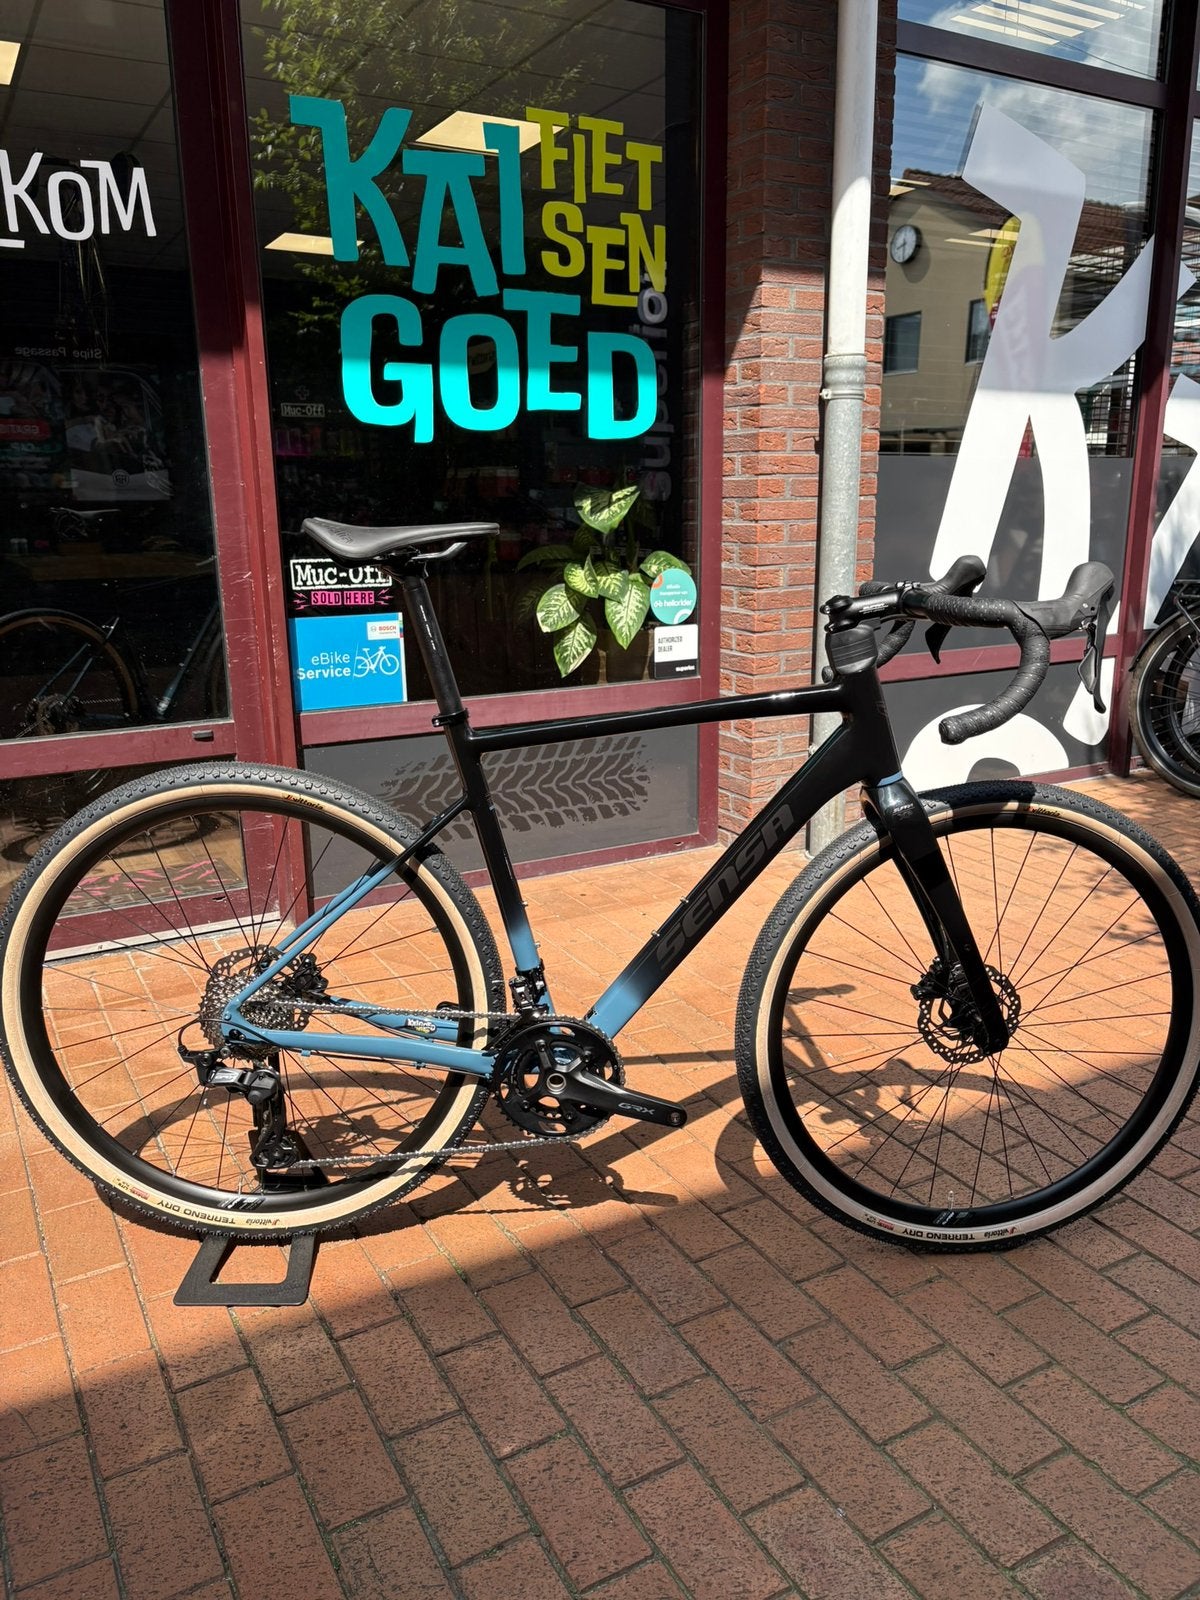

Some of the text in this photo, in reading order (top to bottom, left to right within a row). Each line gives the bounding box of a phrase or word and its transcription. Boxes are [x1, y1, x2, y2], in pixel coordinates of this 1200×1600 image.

[525, 106, 664, 211] FIET
[0, 148, 158, 249] KOM
[288, 94, 527, 298] KAI
[540, 201, 667, 308] SEN
[339, 288, 657, 444] GOED
[312, 591, 374, 605] SOLD HERE
[311, 651, 351, 666] eBike
[658, 645, 673, 653] DEALER
[296, 665, 352, 680] Service
[655, 803, 794, 973] SENSA
[617, 1102, 657, 1116] GRX
[157, 1200, 273, 1226] vittoria TERRENO DRY
[901, 1227, 1009, 1241] vittoria TERRENO DRY
